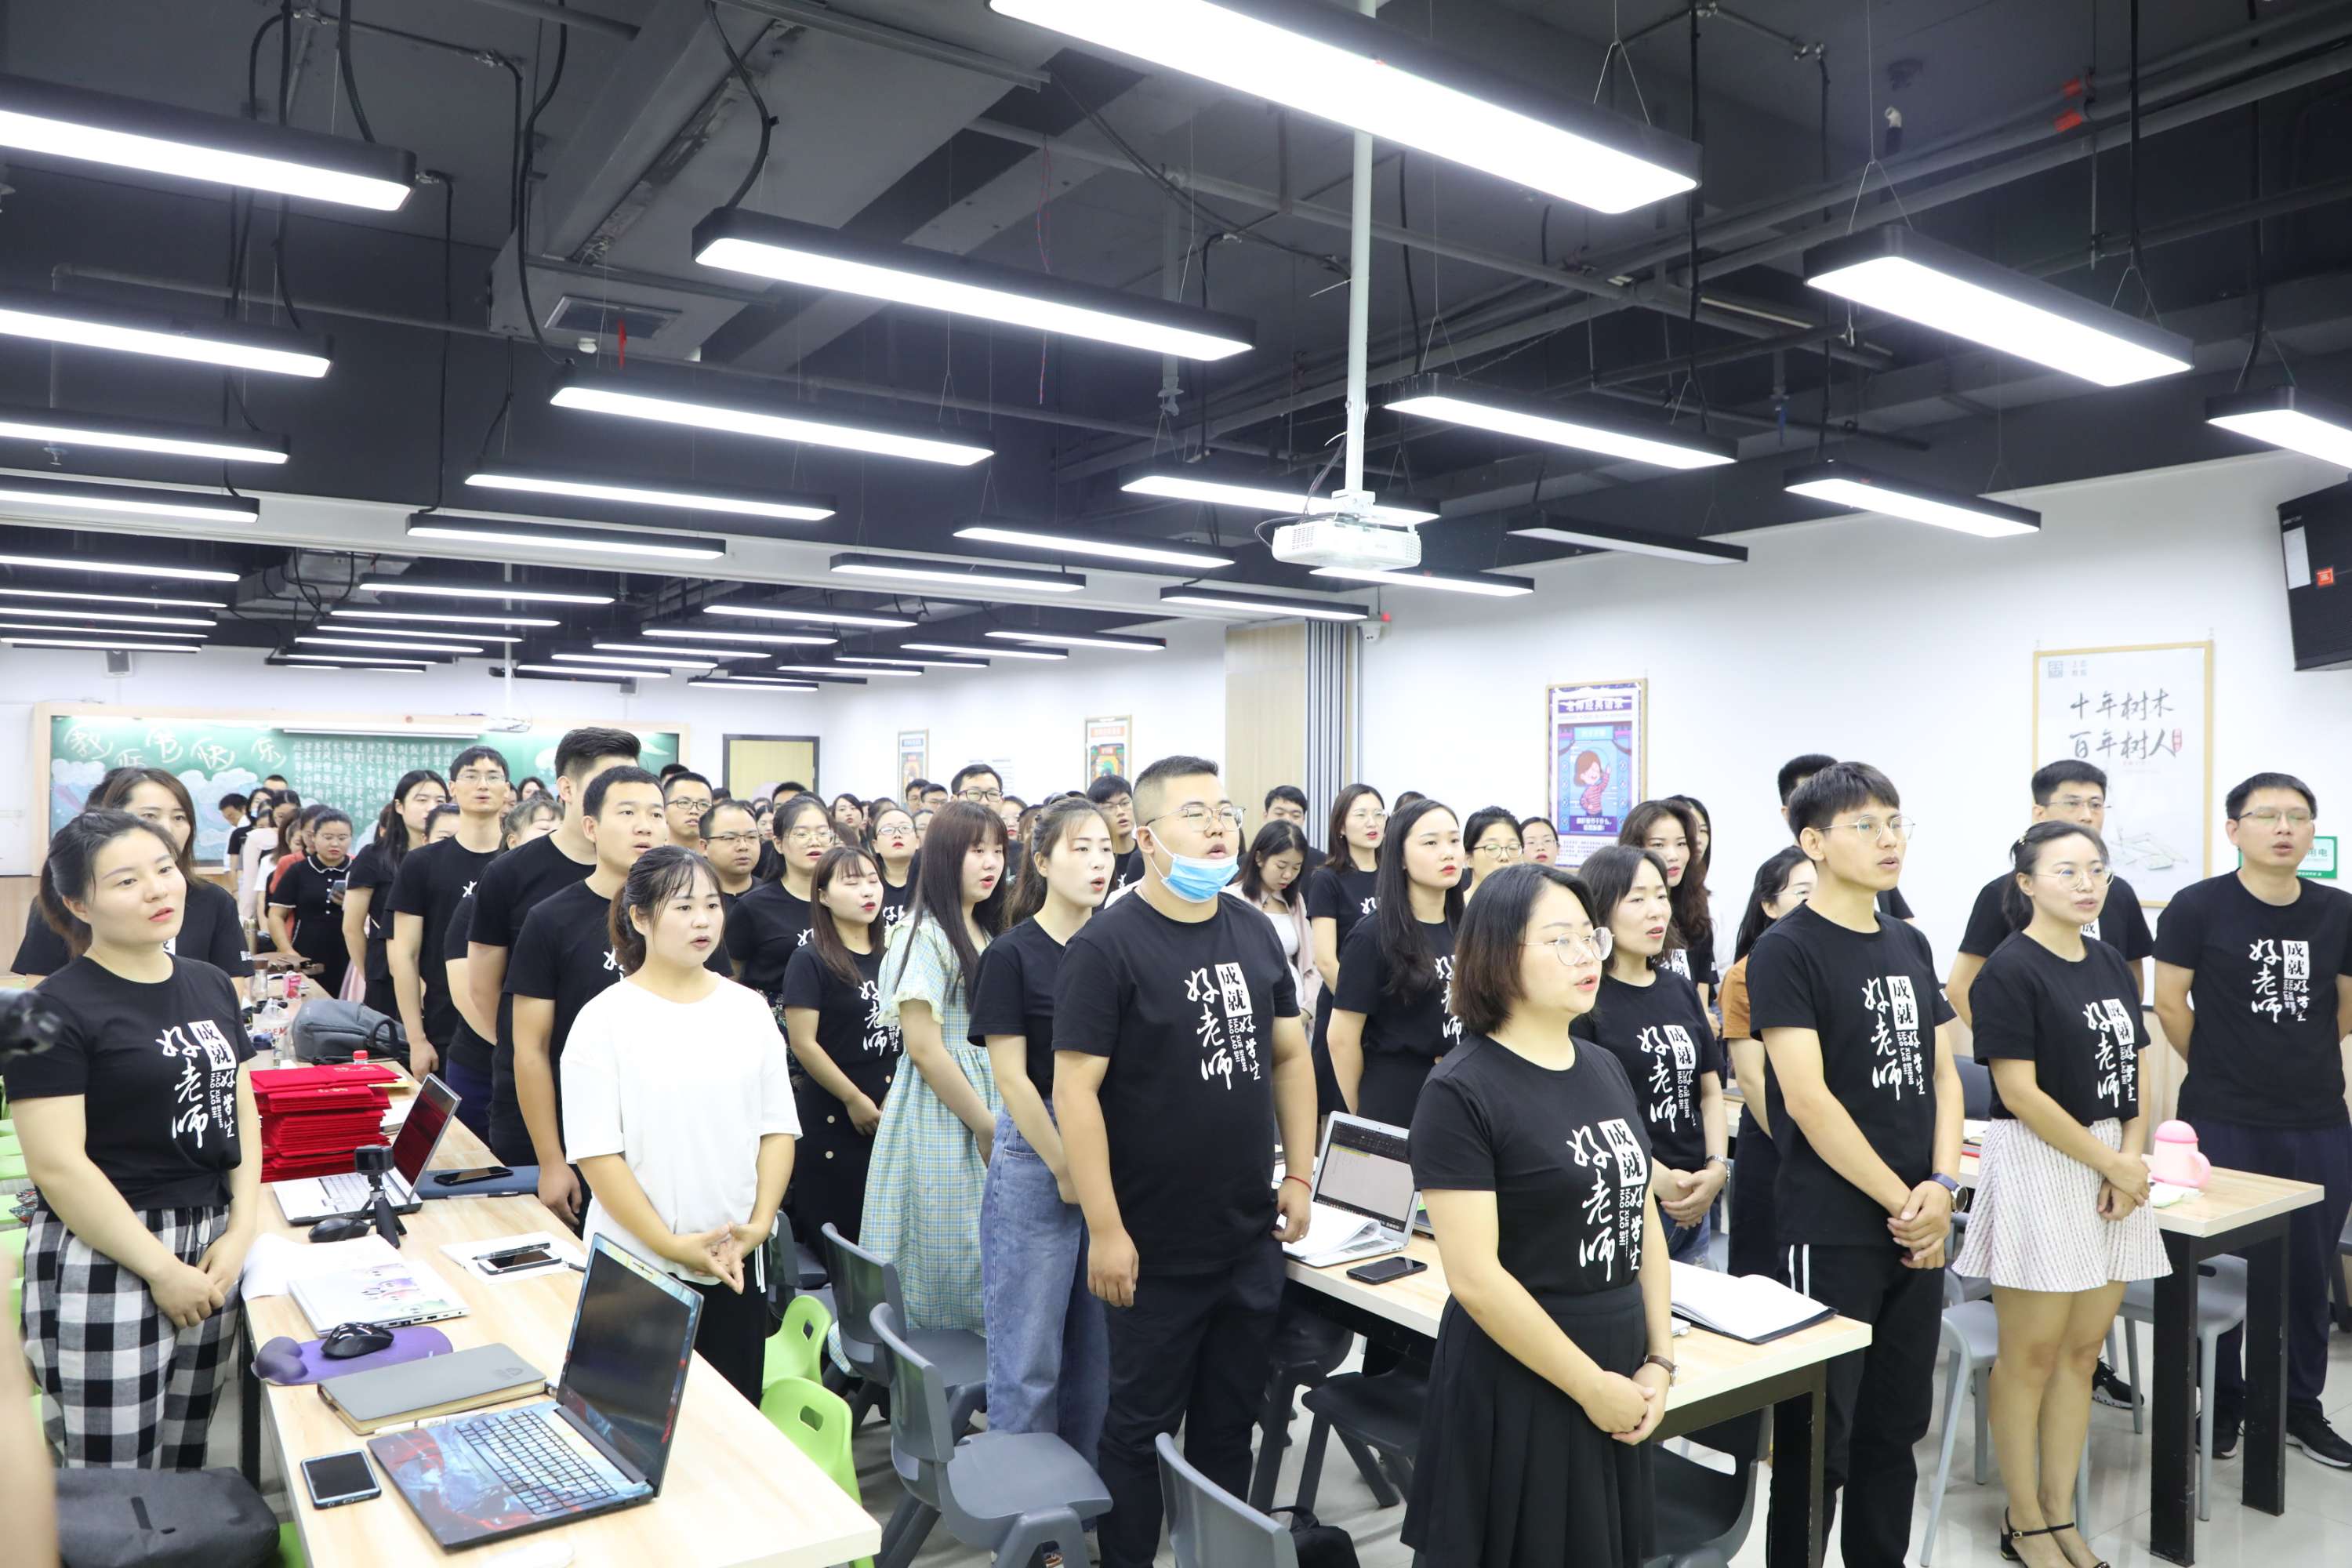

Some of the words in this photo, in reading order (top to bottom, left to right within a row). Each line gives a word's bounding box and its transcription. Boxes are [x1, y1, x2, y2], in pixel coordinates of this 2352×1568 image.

[2070, 688, 2175, 720] 十年树木
[2069, 728, 2176, 760] 百年树人
[2249, 938, 2283, 1023] 好老师
[2287, 942, 2305, 976] 成就
[1220, 966, 1247, 1011] 成就
[1893, 978, 1914, 1025] 成就
[2292, 980, 2310, 1022] 好学生
[196, 1023, 232, 1065] 成就
[858, 980, 887, 1057] 好老师
[1184, 967, 1233, 1091] 好老师
[1230, 1035, 1239, 1050] LAO
[1240, 1015, 1261, 1080] 好学生
[1669, 1027, 1693, 1065] 成就
[1861, 977, 1903, 1101] 好老师
[2107, 1002, 2131, 1040] 成就
[1239, 1050, 1248, 1073] SHENG
[1636, 1025, 1677, 1133] 好老师
[1907, 1030, 1926, 1095] 好学生
[2082, 1002, 2120, 1109] 好老师
[2125, 1044, 2137, 1102] 好学生
[155, 1025, 209, 1149] 好老师
[220, 1069, 235, 1138] 好学生
[1607, 1123, 1643, 1179] 成就
[1566, 1125, 1615, 1283] 好老师
[1629, 1185, 1644, 1271] 好学生
